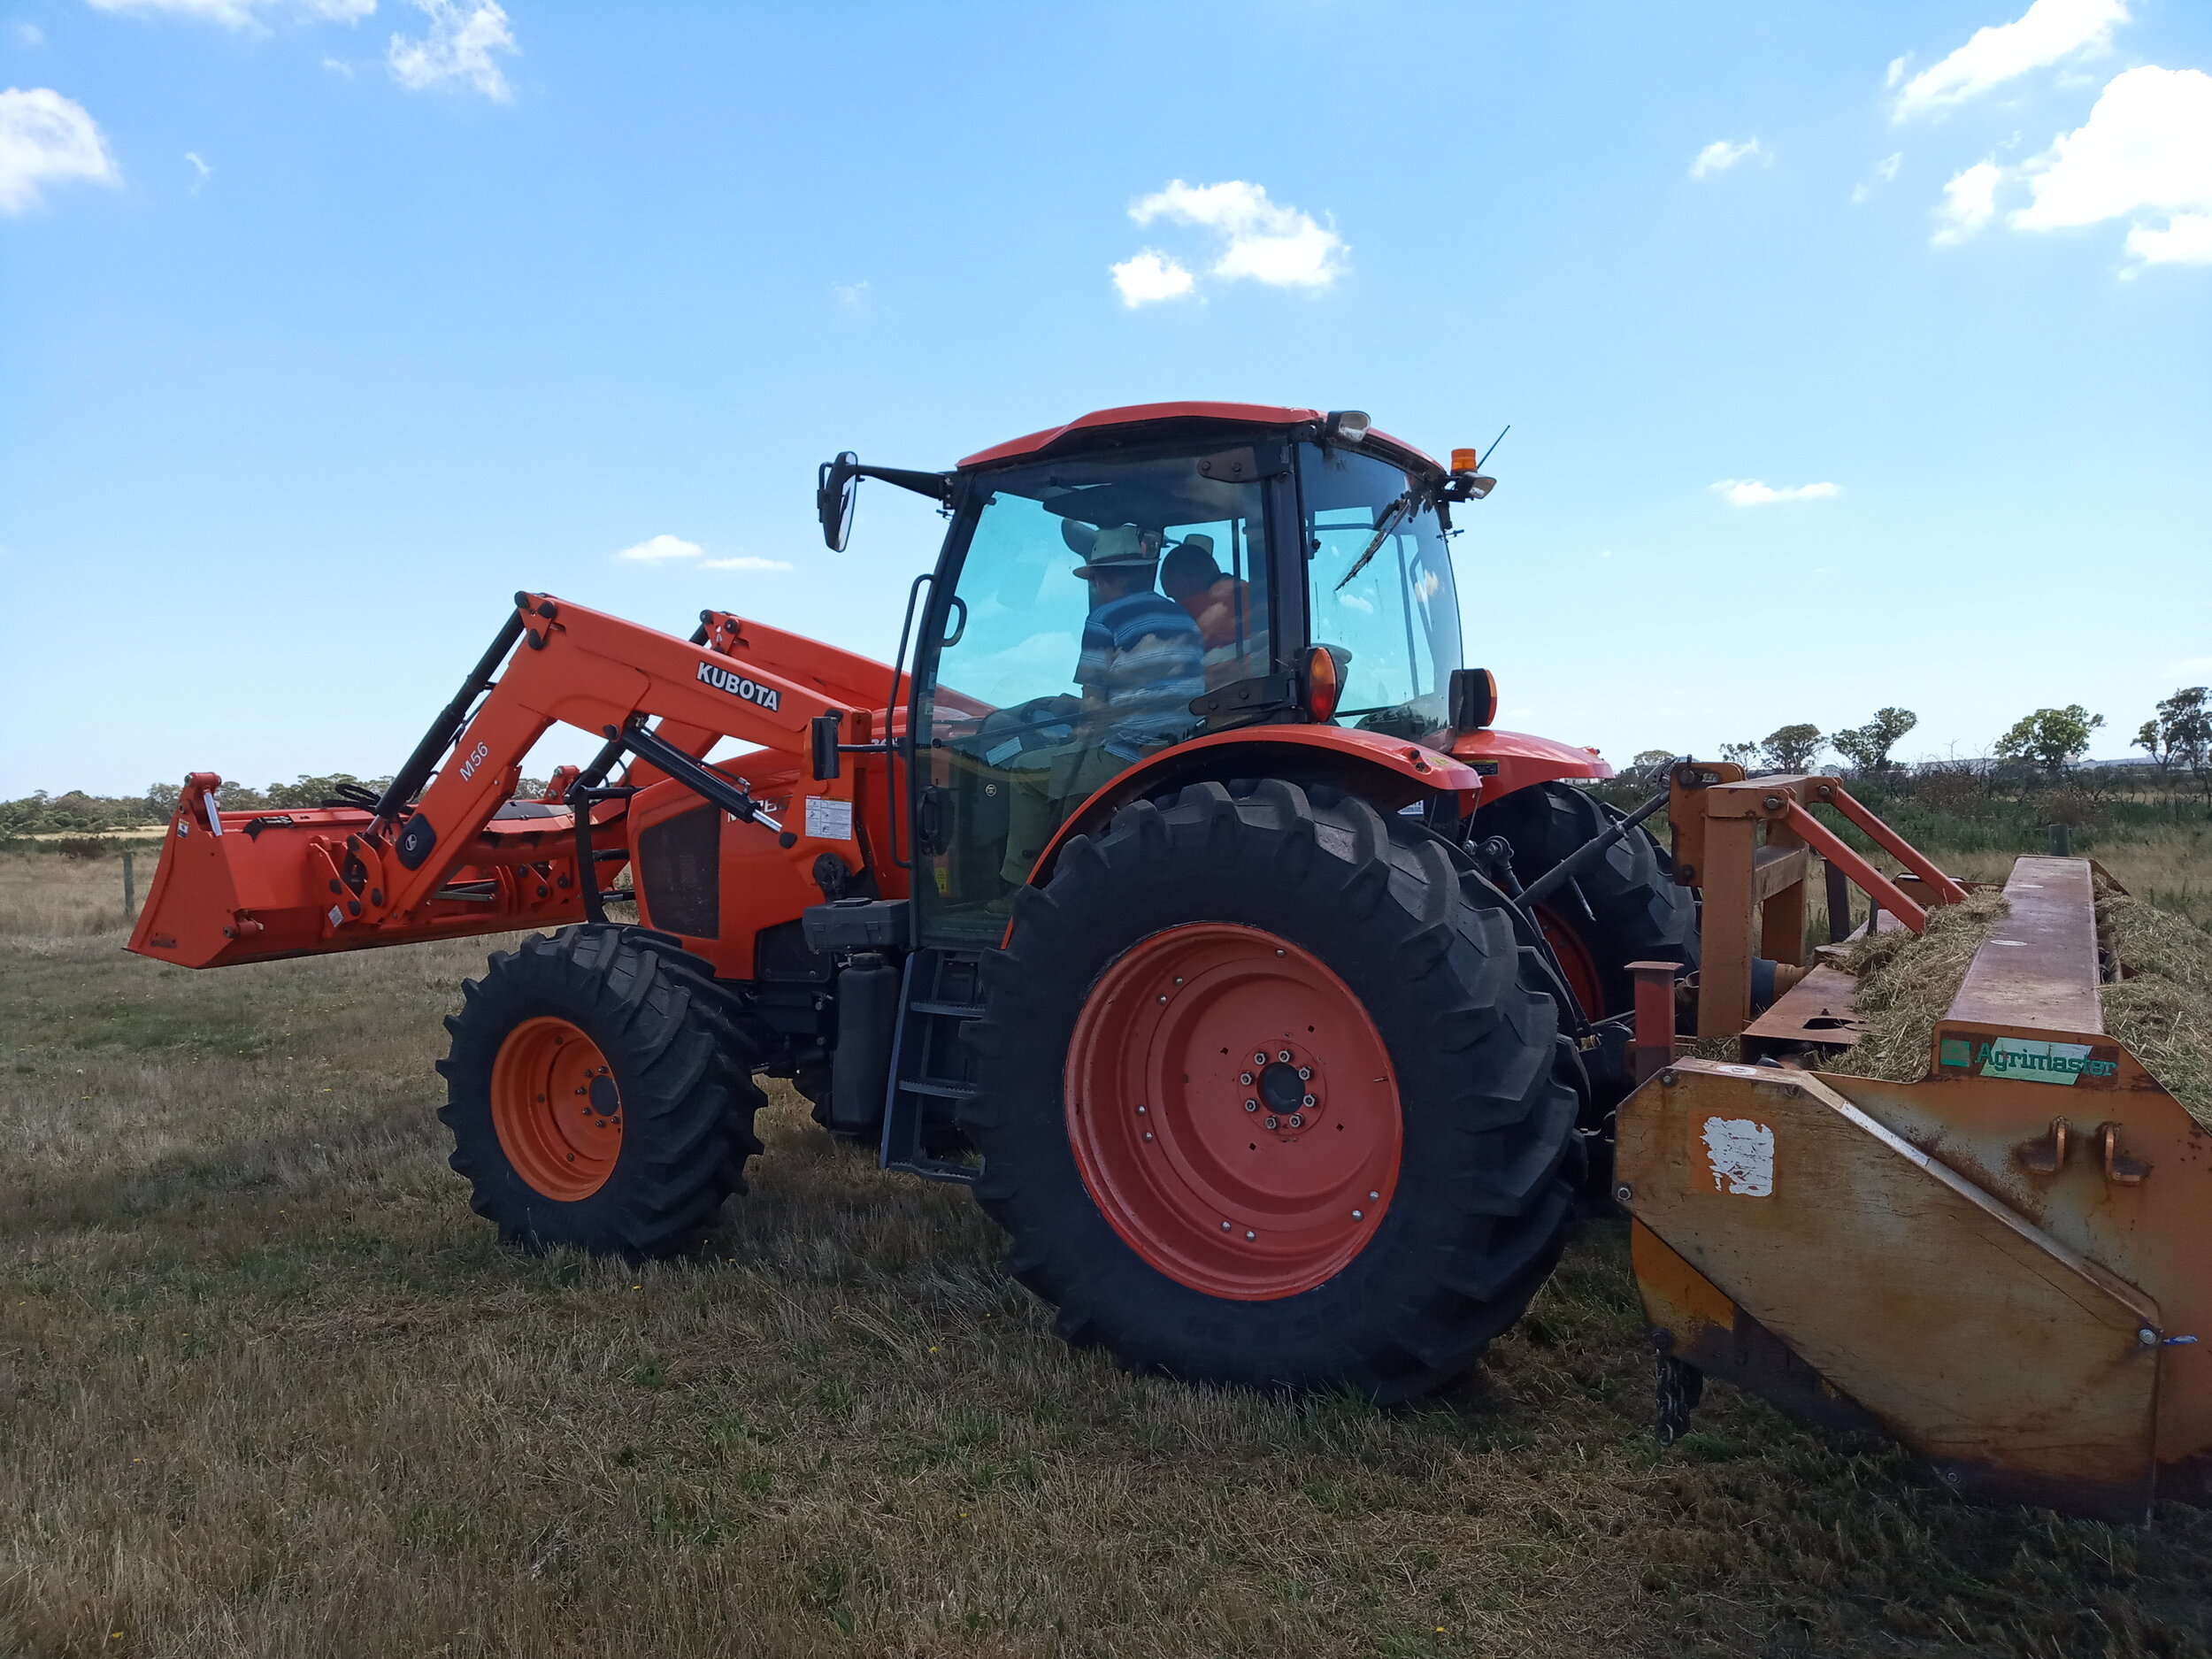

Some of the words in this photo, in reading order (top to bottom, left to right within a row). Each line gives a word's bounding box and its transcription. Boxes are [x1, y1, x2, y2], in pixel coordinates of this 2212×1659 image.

[697, 662, 778, 711] KUBOTA
[459, 741, 488, 781] M56
[1976, 1041, 2116, 1076] Agrimaster
